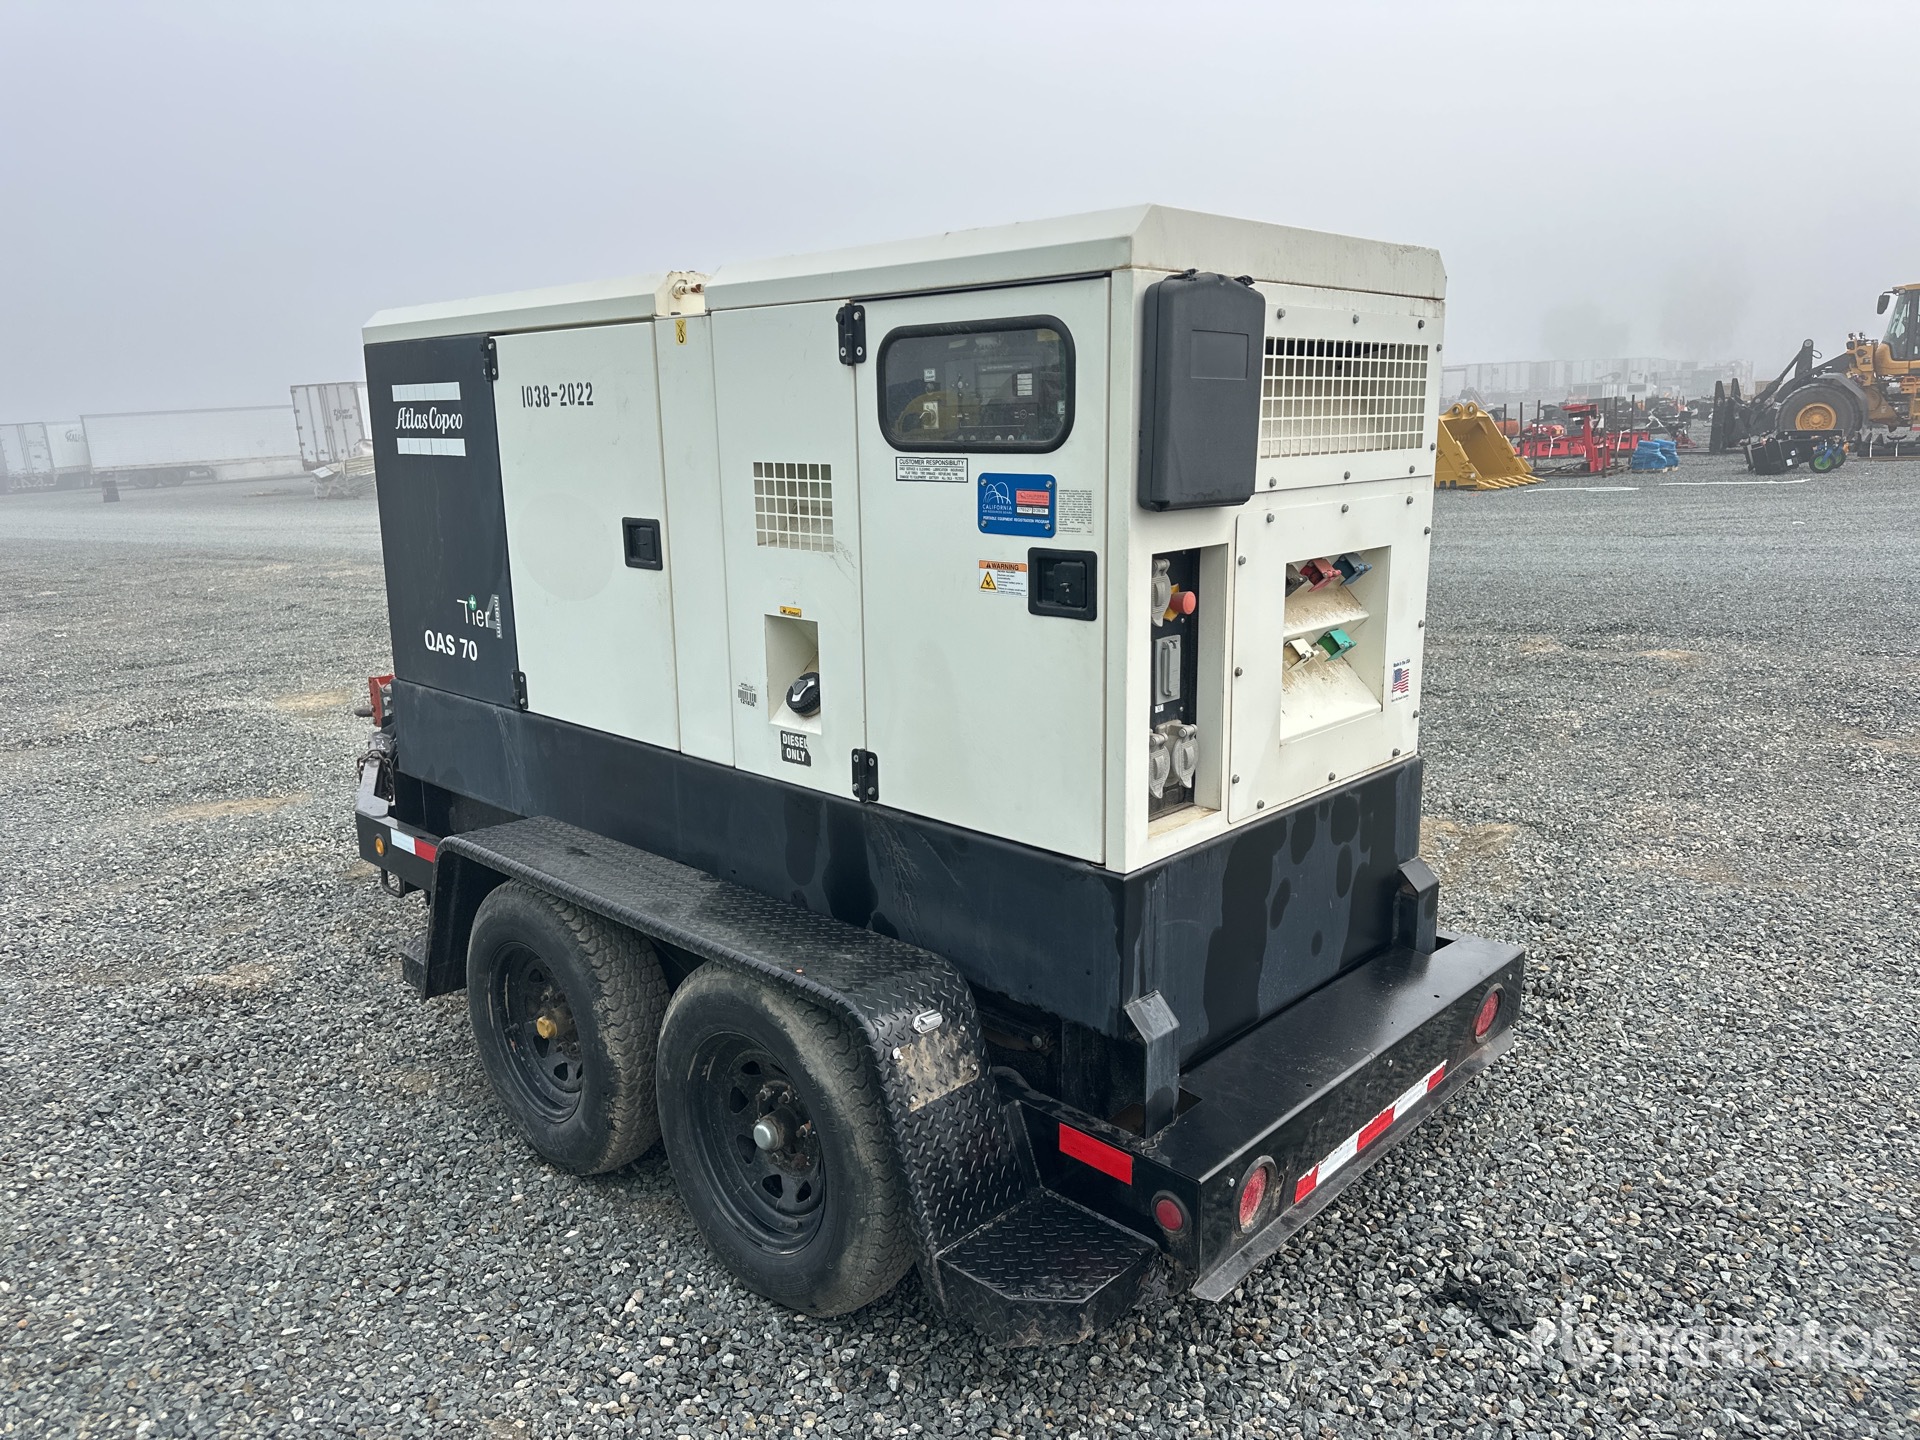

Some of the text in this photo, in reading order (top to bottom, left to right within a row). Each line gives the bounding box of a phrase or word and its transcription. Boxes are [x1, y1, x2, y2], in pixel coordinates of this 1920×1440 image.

[521, 382, 594, 408] 1038-2022
[395, 406, 463, 435] Atlas Copco
[992, 563, 1019, 571] WARNING
[424, 629, 478, 661] QAS 70
[782, 733, 808, 749] DIESEL
[786, 747, 806, 762] ONLY
